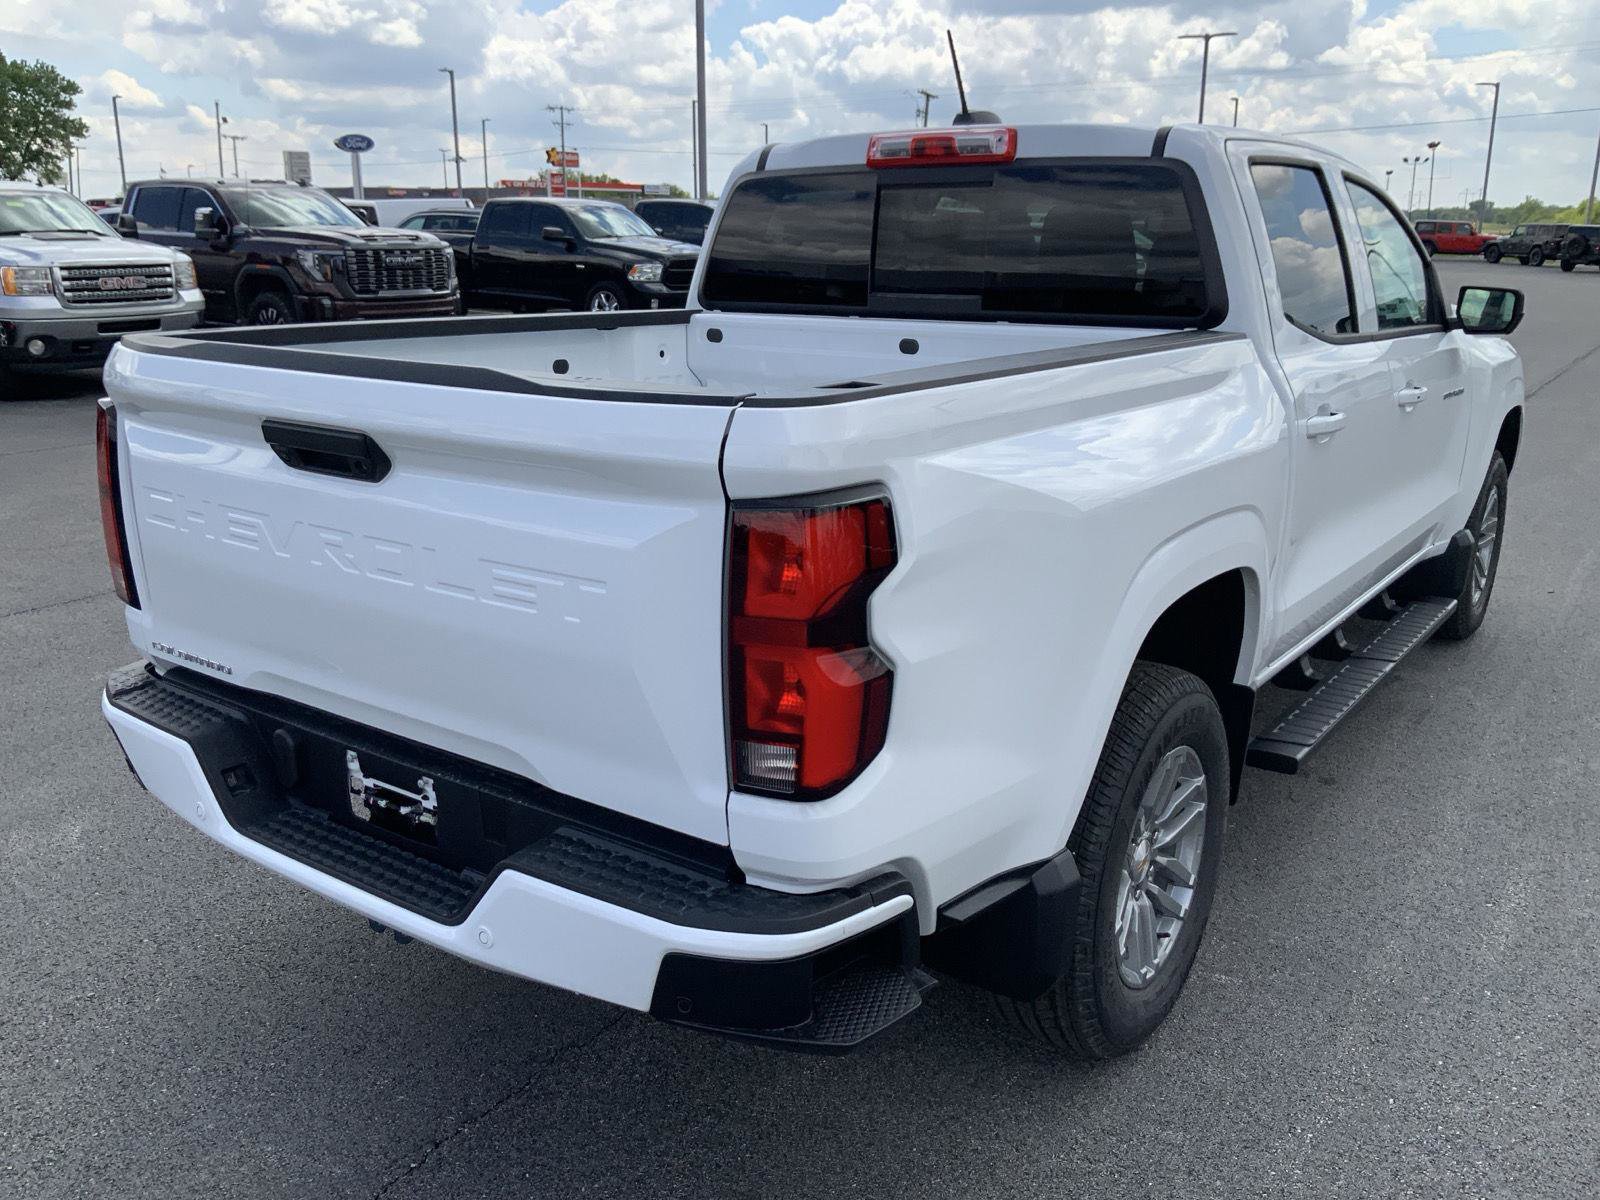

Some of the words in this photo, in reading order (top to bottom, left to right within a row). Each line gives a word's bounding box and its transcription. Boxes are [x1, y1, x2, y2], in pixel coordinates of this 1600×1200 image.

[345, 137, 368, 148] Ford
[99, 276, 148, 290] GMC
[142, 486, 607, 623] CHEVROLET
